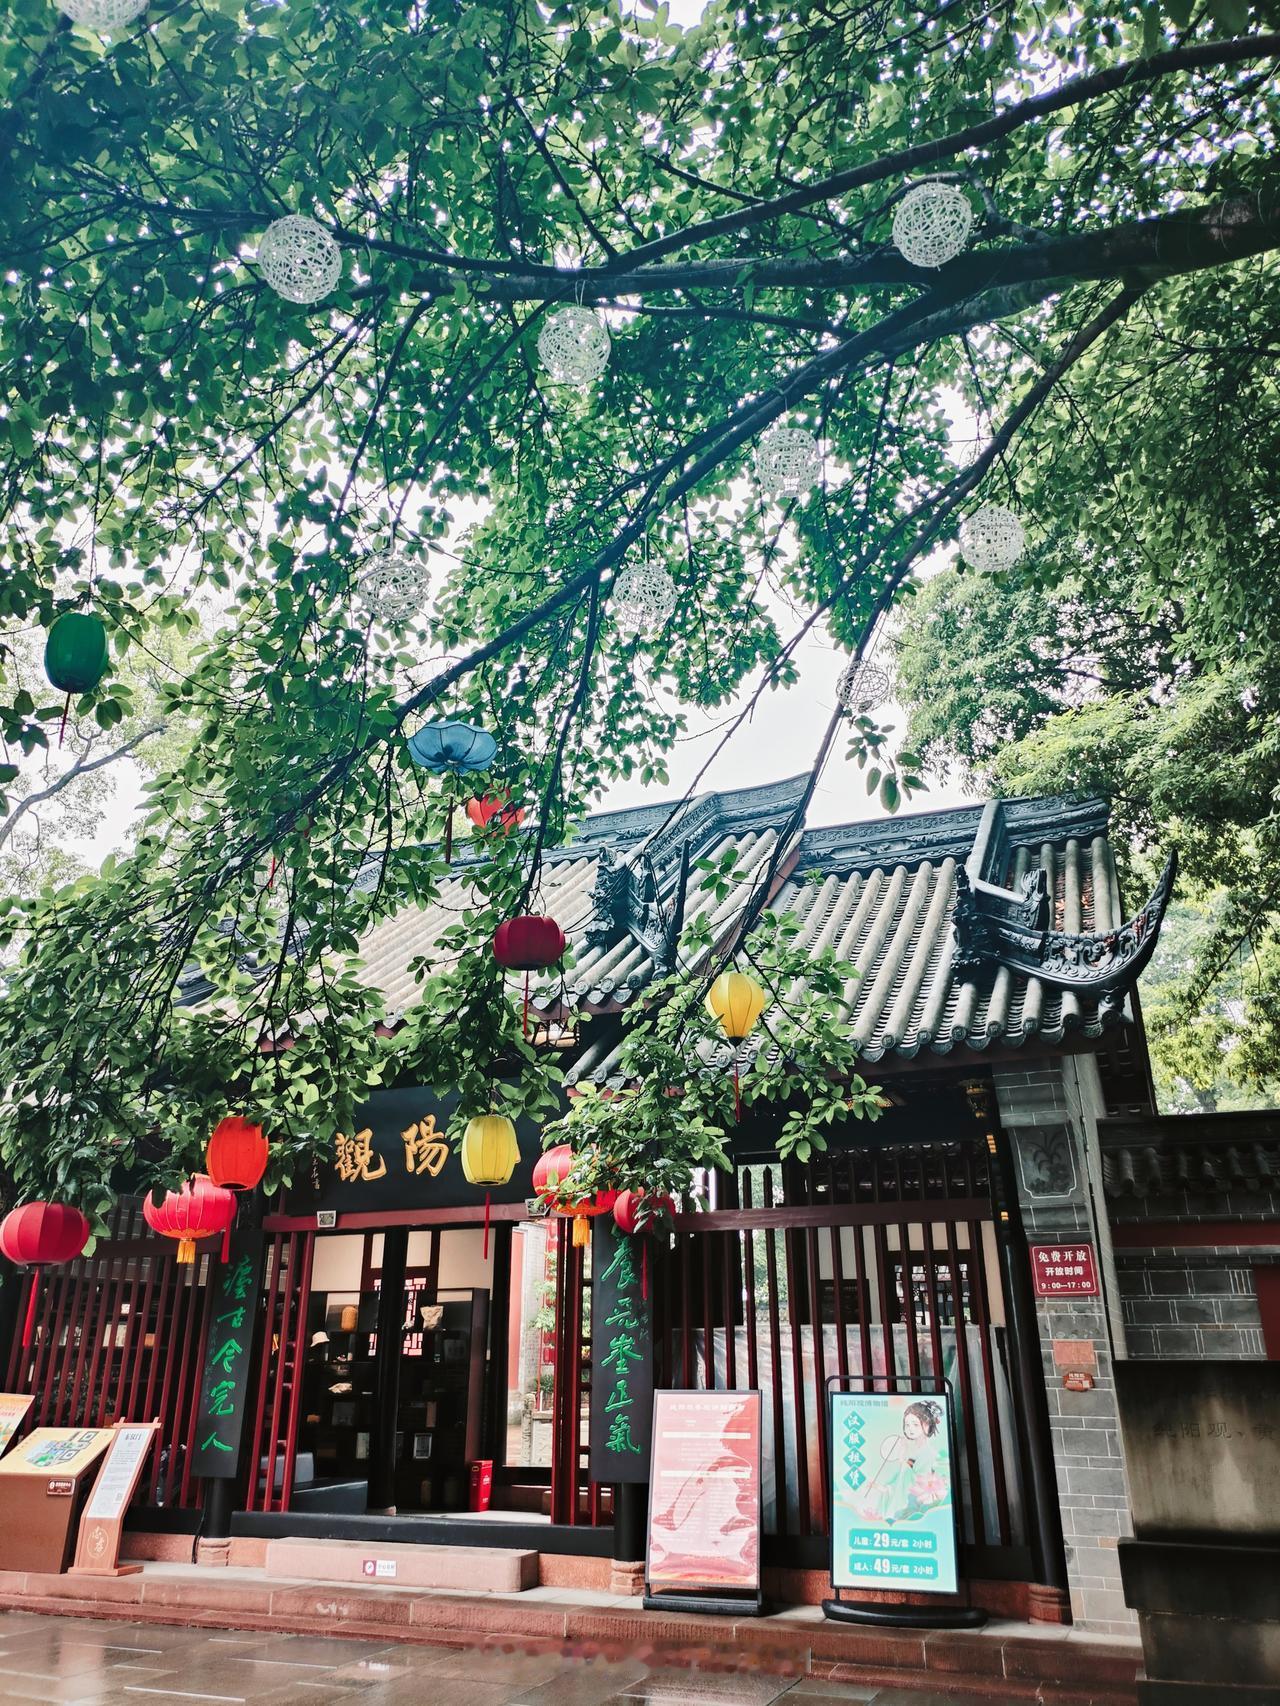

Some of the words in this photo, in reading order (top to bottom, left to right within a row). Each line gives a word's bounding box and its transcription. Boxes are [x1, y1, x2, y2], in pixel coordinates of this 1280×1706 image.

[1039, 1250, 1087, 1262] 免费开放
[1045, 1266, 1084, 1276] 开放时间
